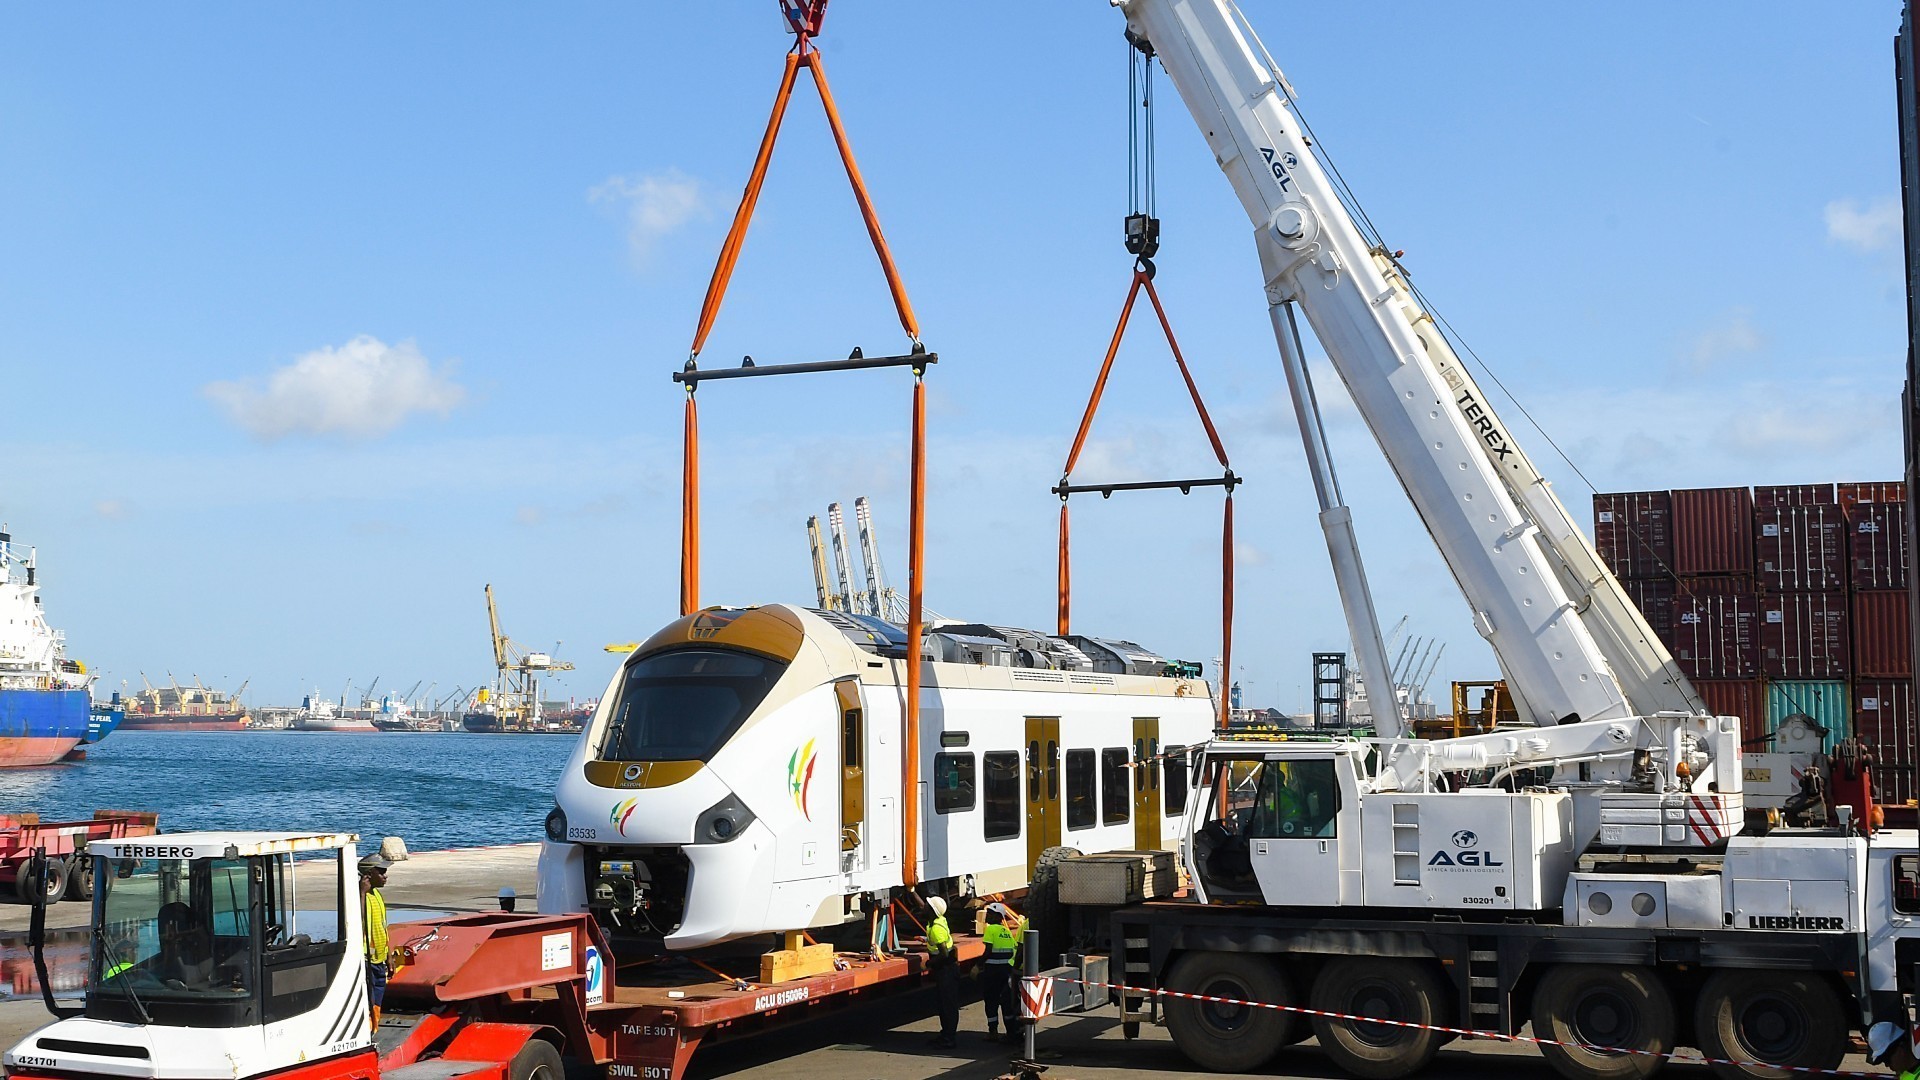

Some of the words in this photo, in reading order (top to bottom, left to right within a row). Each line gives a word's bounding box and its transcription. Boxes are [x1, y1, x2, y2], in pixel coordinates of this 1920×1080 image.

[1260, 147, 1291, 193] AGL
[1457, 389, 1514, 462] TEREX
[1858, 521, 1879, 529] ACL
[1681, 612, 1701, 620] ACL
[1025, 747, 1031, 761] 2
[1056, 746, 1061, 760] 2
[568, 827, 597, 840] 83533
[113, 846, 194, 858] TERBERG
[1427, 850, 1504, 867] AGL
[1748, 915, 1845, 930] LIEBHERR
[754, 994, 776, 1011] ACLU
[18, 1056, 57, 1067] 421701
[608, 1064, 638, 1078] SWL
